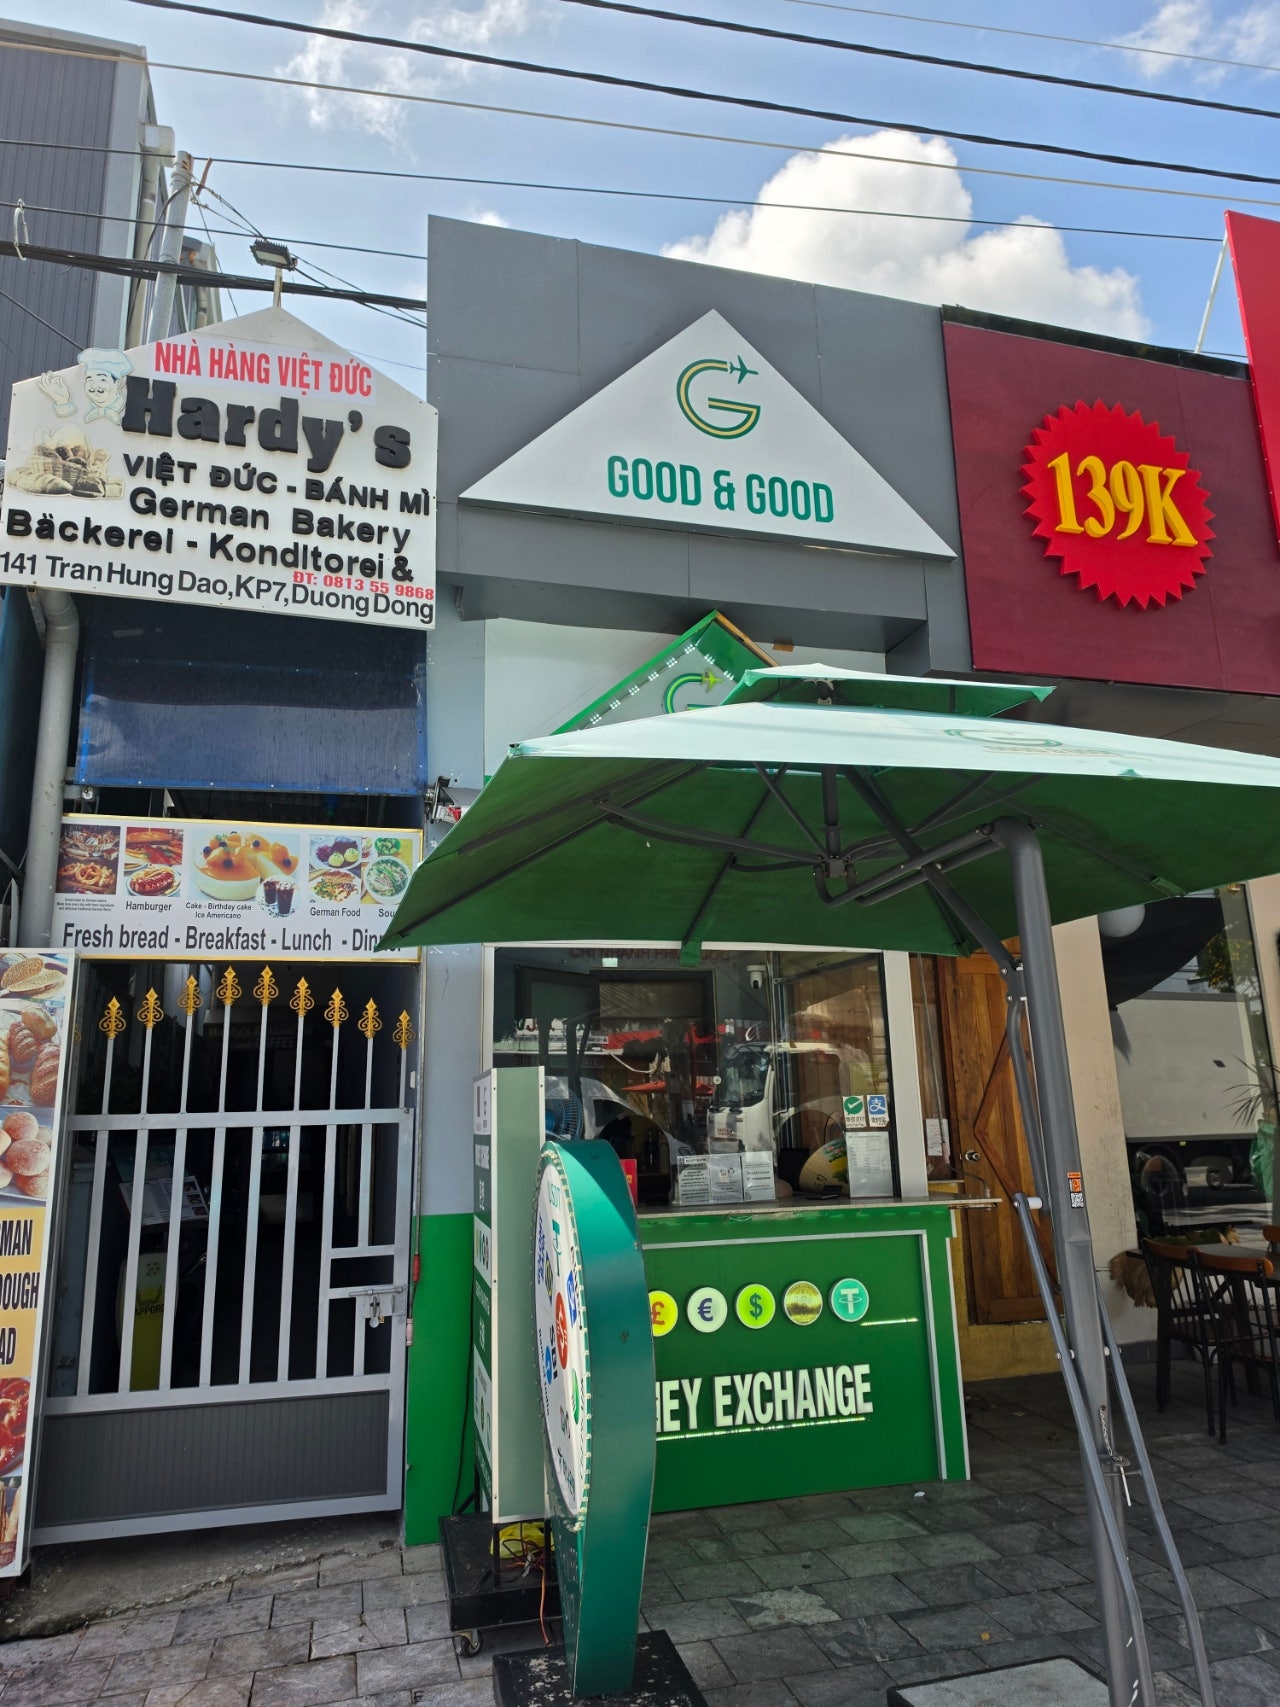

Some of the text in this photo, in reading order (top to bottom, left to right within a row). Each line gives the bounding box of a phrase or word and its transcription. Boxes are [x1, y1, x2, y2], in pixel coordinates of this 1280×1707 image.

[155, 339, 372, 397] NHÀ HÀNG VIỆT ĐỨC
[122, 375, 411, 473] Hardy's
[123, 452, 197, 486] VIỆT
[210, 463, 277, 493] ĐỨC
[305, 476, 388, 510] BÁNH
[400, 488, 430, 516] MÌ
[607, 455, 834, 523] GOOD & GOOD
[1047, 451, 1199, 548] 139K
[130, 487, 411, 553] German Bakery
[6, 508, 173, 553] Bäckerei
[210, 532, 384, 579] Konditorei
[391, 556, 414, 582] &
[0, 552, 37, 575] 141
[45, 555, 102, 580] Tran
[107, 562, 173, 595] Hung
[374, 593, 434, 624] Dong
[293, 570, 434, 600] ĐT: 0813 55 9868
[125, 901, 172, 912] Hamburger
[186, 902, 202, 910] Cake
[208, 903, 235, 911] Birthday
[310, 907, 360, 917] German Food
[378, 909, 396, 917] Sou
[63, 923, 113, 947] Fresh
[119, 924, 169, 949] bread
[185, 926, 266, 950] Breakfast
[282, 928, 332, 951] Lunch
[352, 928, 400, 952] Din
[0, 1220, 33, 1256] MAN
[0, 1272, 40, 1310] OUGH
[135, 1304, 164, 1316] APPORO
[656, 1378, 702, 1432] EY
[714, 1364, 873, 1428] EXCHANGE
